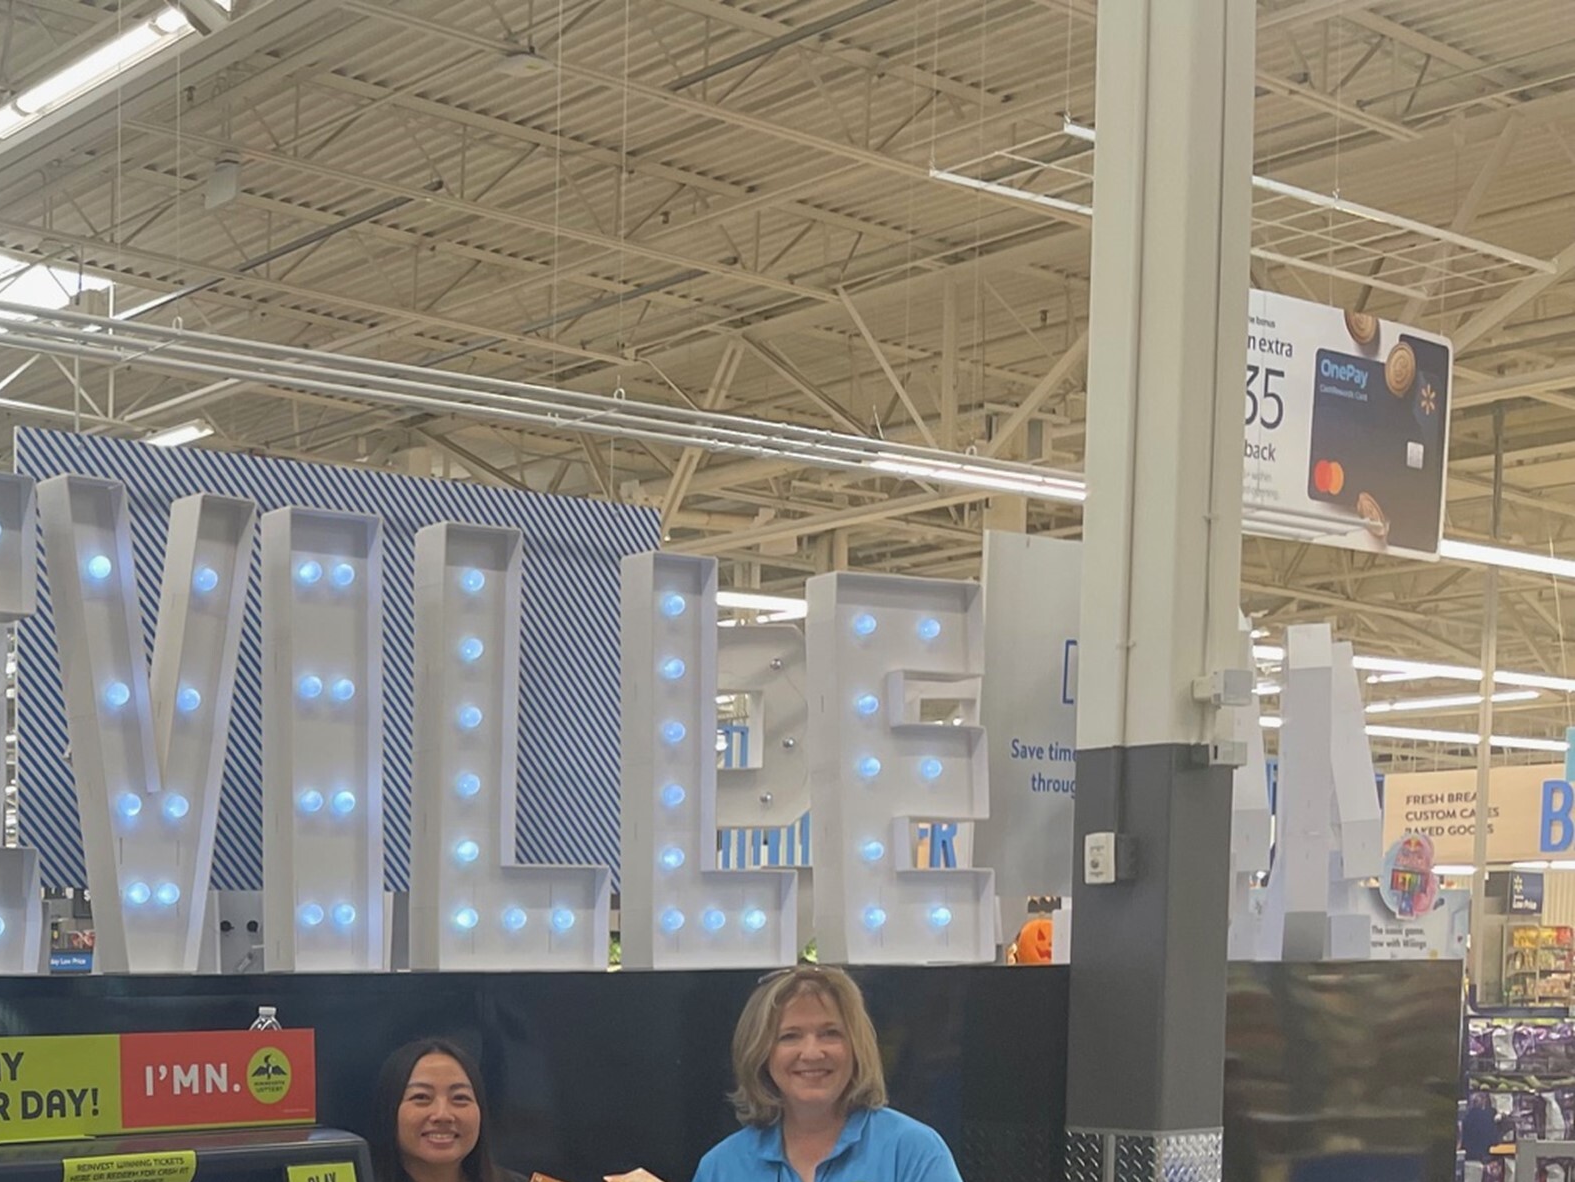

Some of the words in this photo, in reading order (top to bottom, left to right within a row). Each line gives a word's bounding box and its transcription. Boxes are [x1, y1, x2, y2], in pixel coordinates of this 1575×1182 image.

[1258, 340, 1293, 358] extra
[1320, 359, 1368, 388] OnePay
[1245, 440, 1276, 461] back
[1011, 738, 1044, 760] Save
[1406, 793, 1445, 805] FRESH
[1405, 809, 1456, 822] CUSTOM
[1460, 806, 1500, 819] CAES
[21, 1087, 100, 1121] DAY!
[155, 1157, 185, 1166] TICKETS
